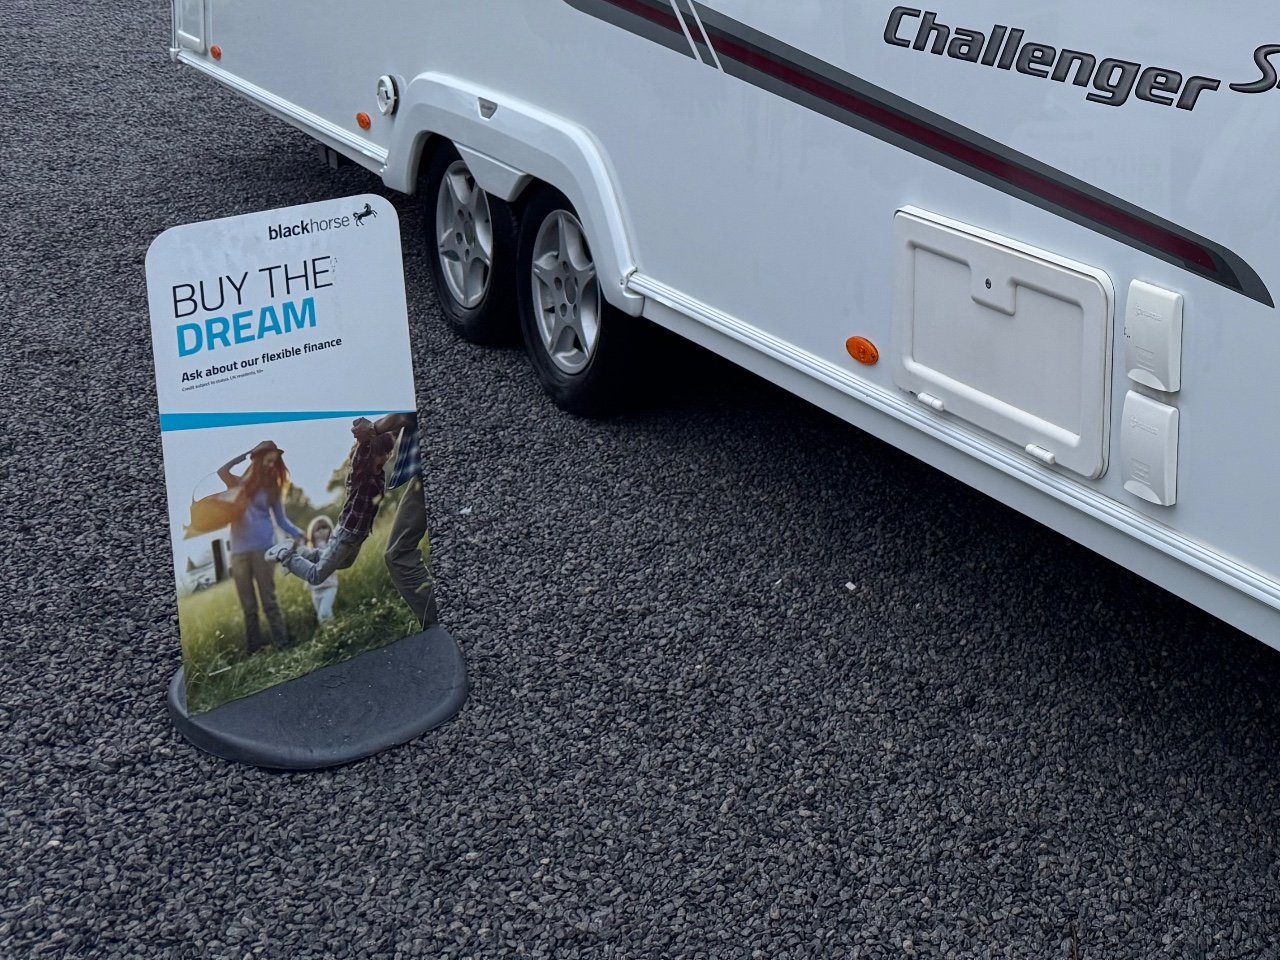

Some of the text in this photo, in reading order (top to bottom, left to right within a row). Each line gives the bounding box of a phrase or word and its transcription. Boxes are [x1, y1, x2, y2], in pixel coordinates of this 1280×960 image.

[883, 5, 1221, 112] Challenger
[172, 255, 333, 319] BUY THE
[176, 296, 317, 357] DREAM
[181, 338, 342, 383] Ask about our flexible finance
